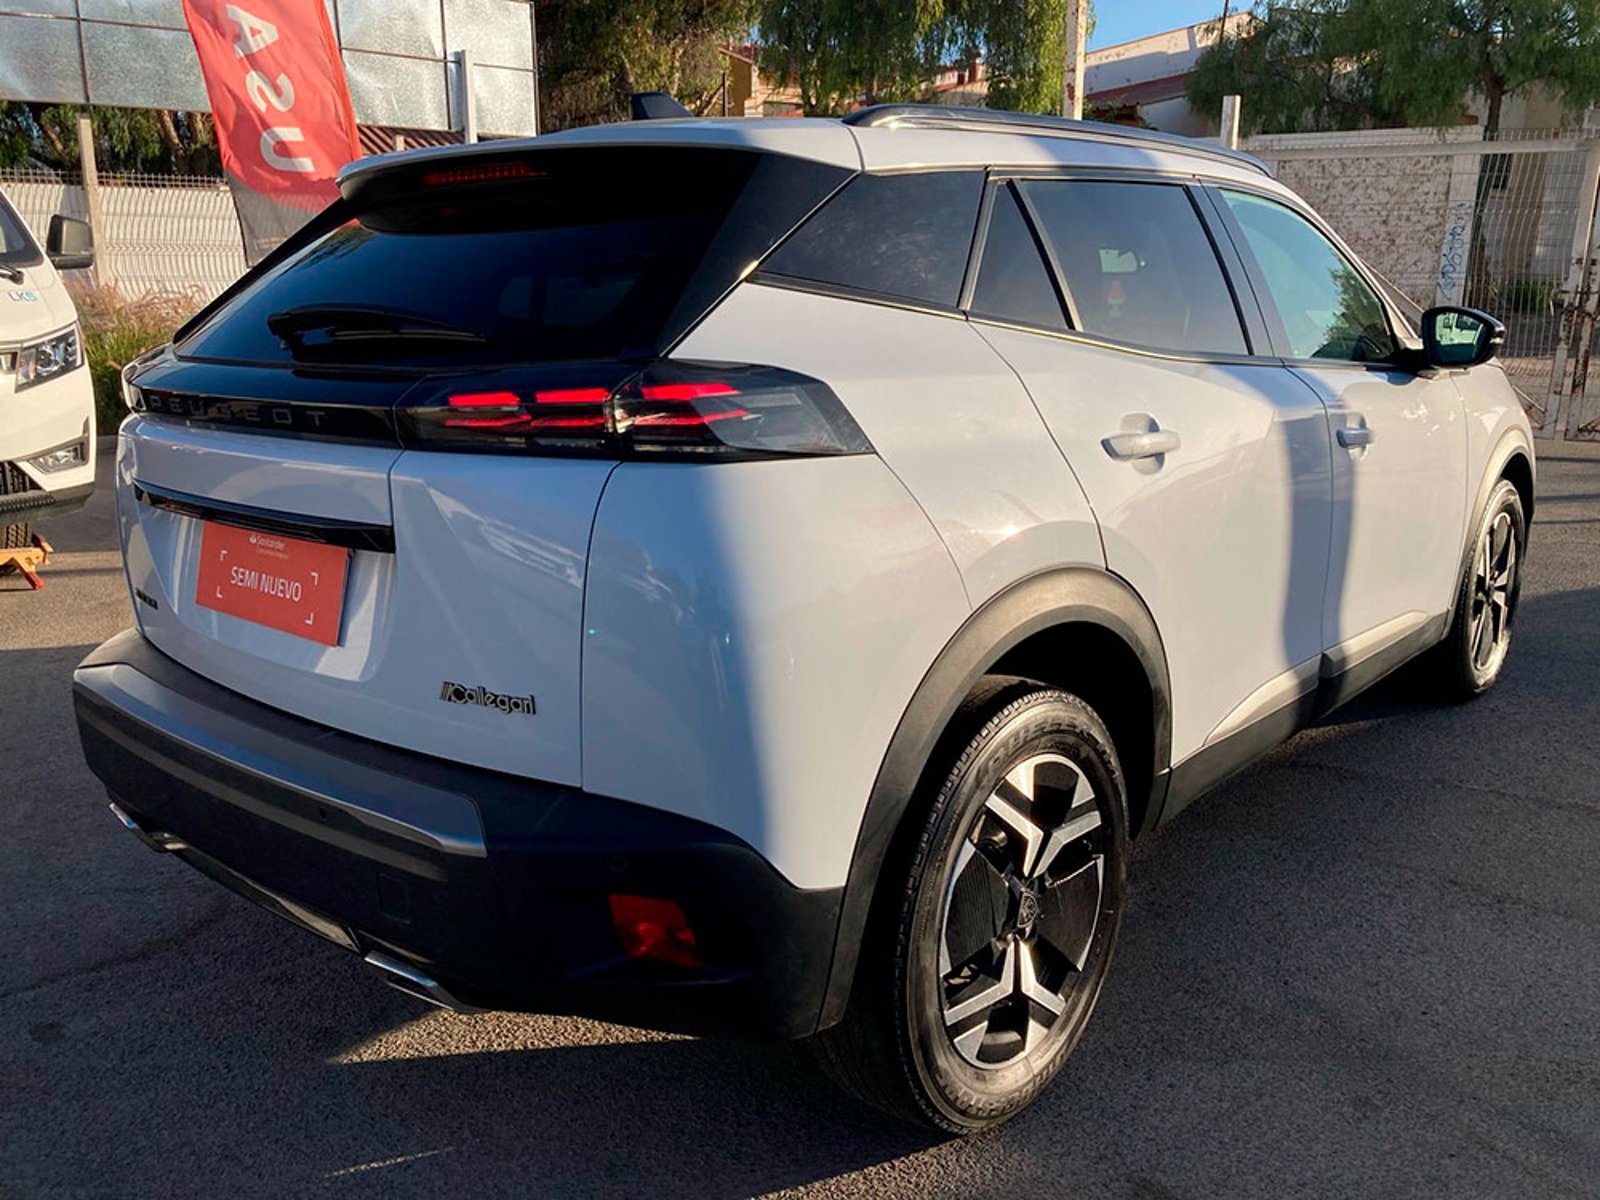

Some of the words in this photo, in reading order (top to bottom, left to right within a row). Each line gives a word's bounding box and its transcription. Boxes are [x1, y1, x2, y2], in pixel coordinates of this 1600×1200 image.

[149, 395, 326, 428] PEUGEOT
[230, 566, 259, 591] SEMI
[260, 574, 302, 602] NUEVO
